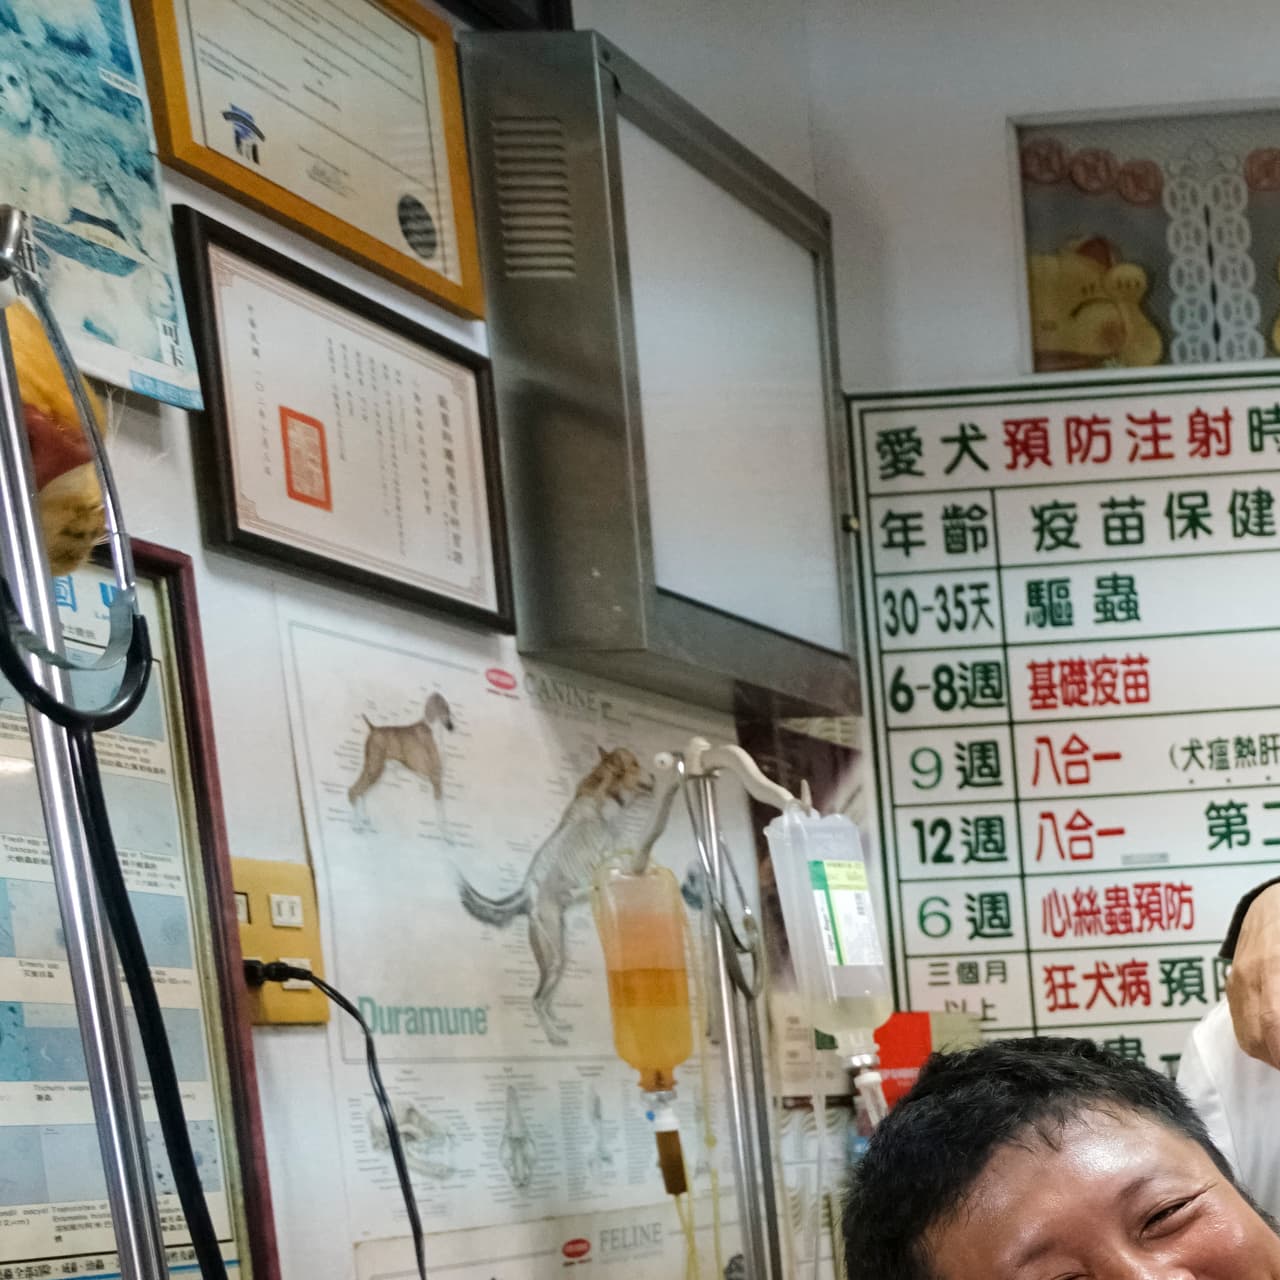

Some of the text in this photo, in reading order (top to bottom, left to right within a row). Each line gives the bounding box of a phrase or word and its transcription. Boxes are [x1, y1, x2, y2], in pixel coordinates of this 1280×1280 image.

[880, 503, 990, 558] 年齡
[882, 572, 1142, 638] 30-35天 驅蟲
[889, 659, 1004, 713] 6-8週
[1026, 654, 1152, 712] 基礎疫苗
[909, 739, 1004, 791] 9週
[1031, 732, 1122, 788] 八合一
[911, 814, 1009, 867] 12週
[1035, 809, 1126, 863] 八合一
[917, 881, 1195, 940] 6週 心絲蟲預防
[928, 959, 1009, 987] 三個月
[358, 997, 488, 1037] Duramune
[600, 1222, 662, 1251] FELINE
